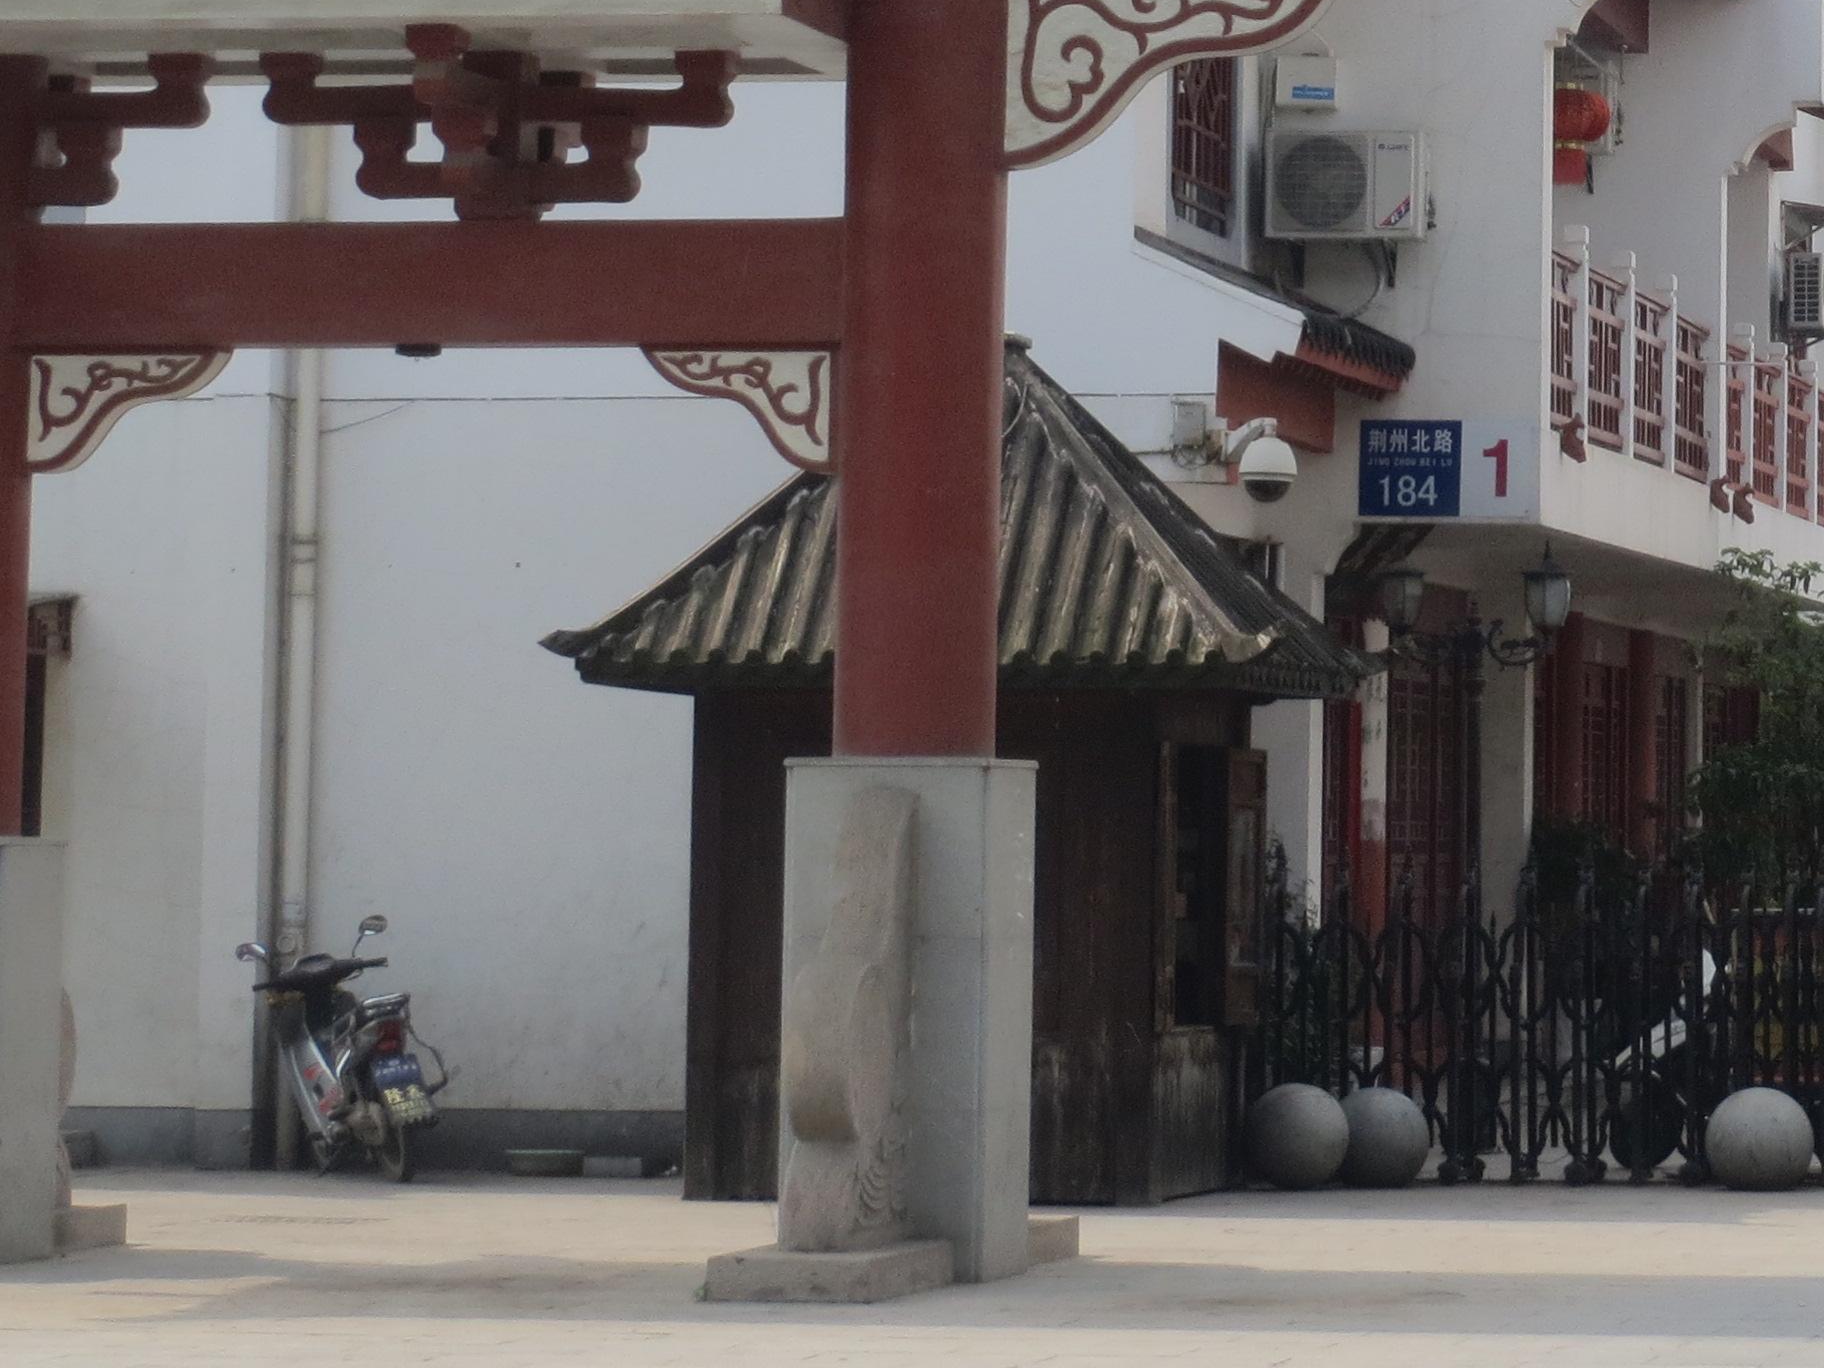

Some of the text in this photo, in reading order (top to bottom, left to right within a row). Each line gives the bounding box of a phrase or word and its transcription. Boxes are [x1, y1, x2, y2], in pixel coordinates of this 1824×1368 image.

[1368, 428, 1453, 453] 荆州北路
[1483, 439, 1509, 497] 1
[1379, 475, 1438, 507] 184
